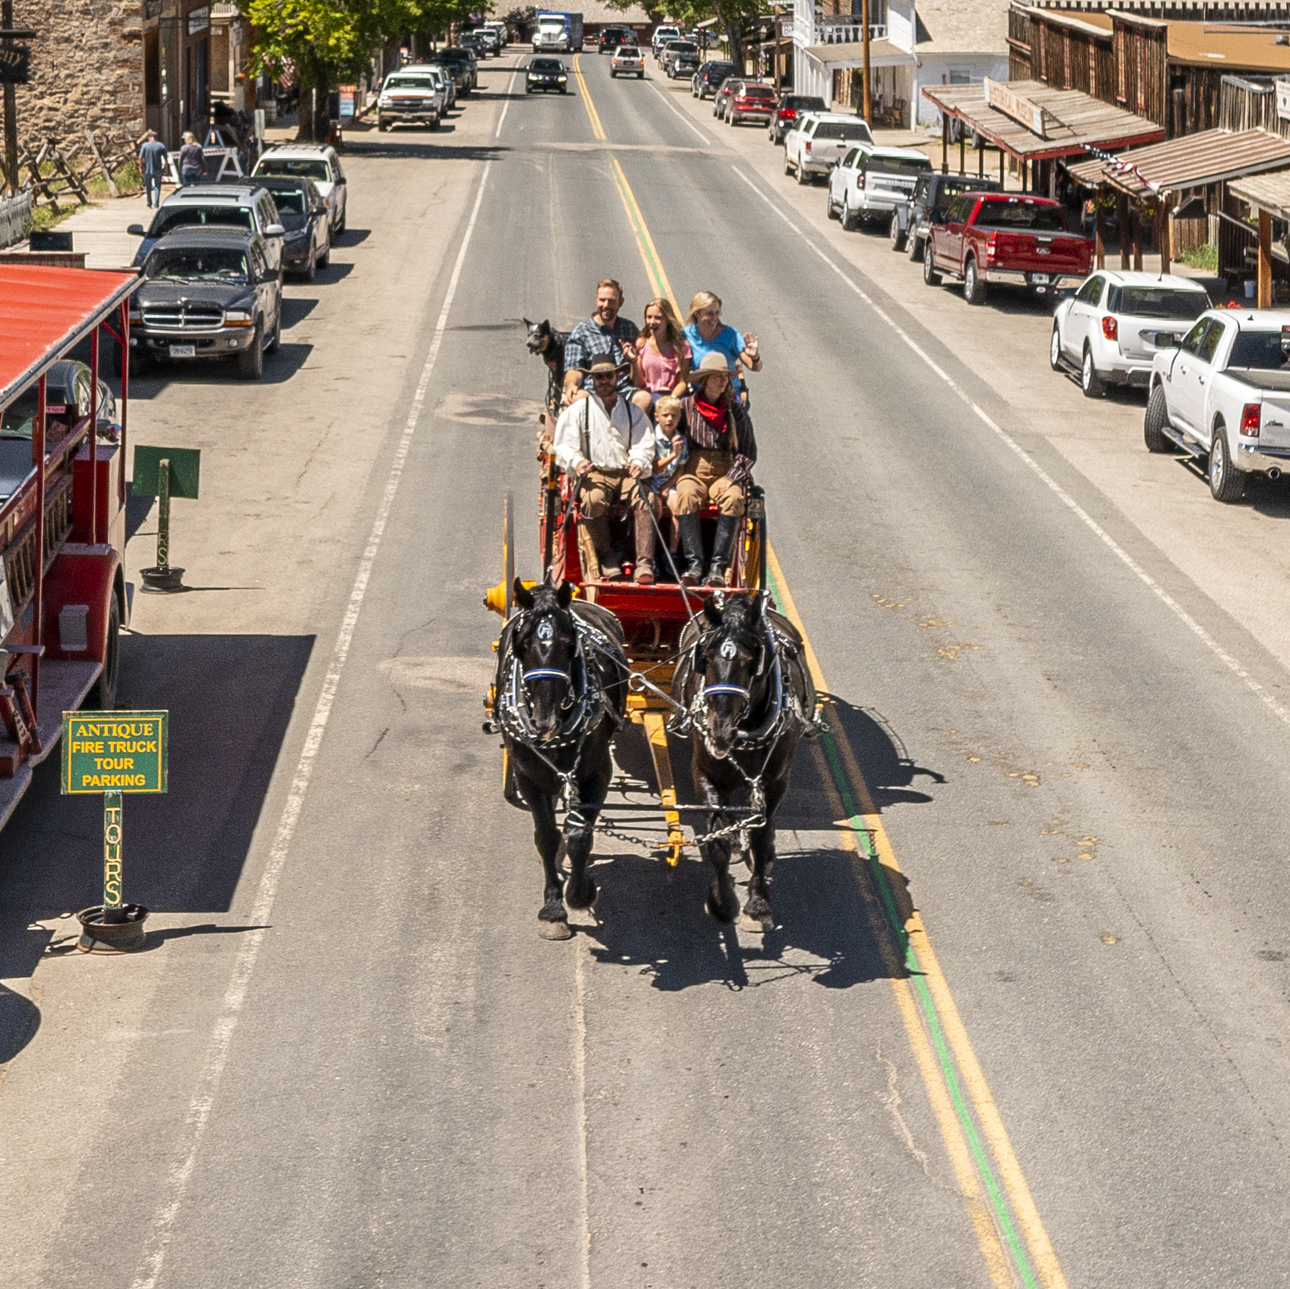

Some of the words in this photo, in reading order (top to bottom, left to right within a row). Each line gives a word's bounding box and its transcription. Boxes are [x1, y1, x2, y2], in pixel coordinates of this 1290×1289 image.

[76, 723, 154, 739] ANTIQUE
[72, 741, 104, 753] FIRE
[107, 740, 158, 753] TRUCK
[94, 758, 134, 770] TOUR
[82, 774, 146, 787] PARKING
[105, 807, 122, 905] TOURS
